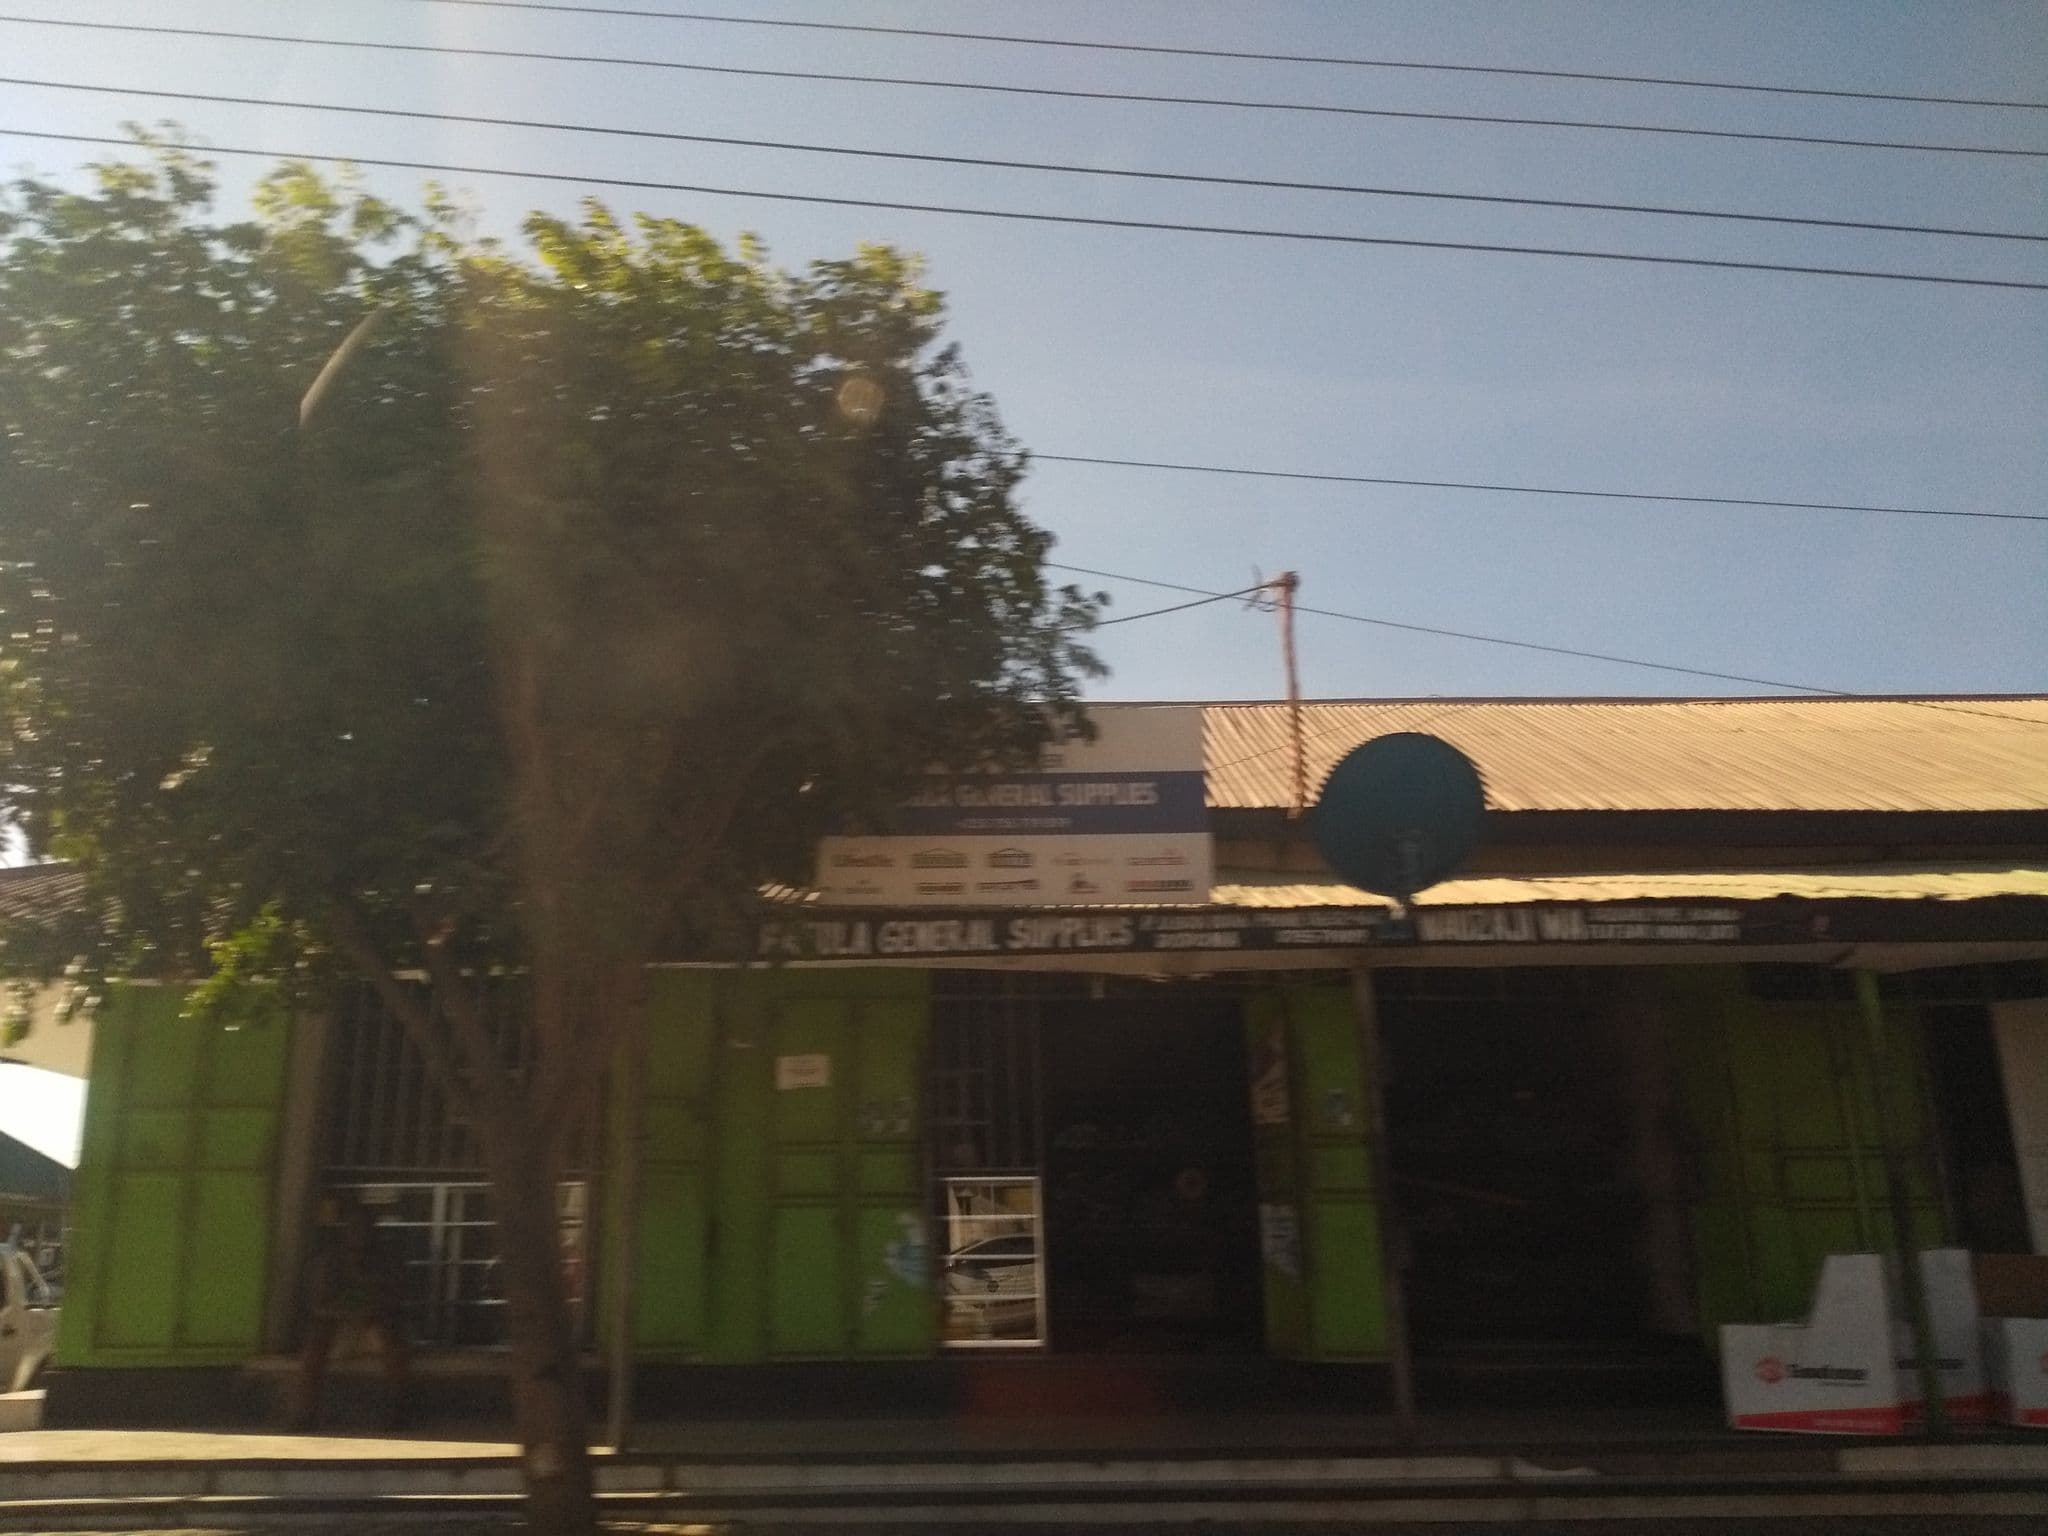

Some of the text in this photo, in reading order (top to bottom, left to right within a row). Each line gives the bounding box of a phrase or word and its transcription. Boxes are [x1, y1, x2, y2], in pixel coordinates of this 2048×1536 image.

[955, 783, 1055, 807] GENERAL
[1056, 781, 1159, 806] SUPPLIES
[876, 919, 1000, 953] GENERAL
[1006, 915, 1134, 950] SUPPLIES
